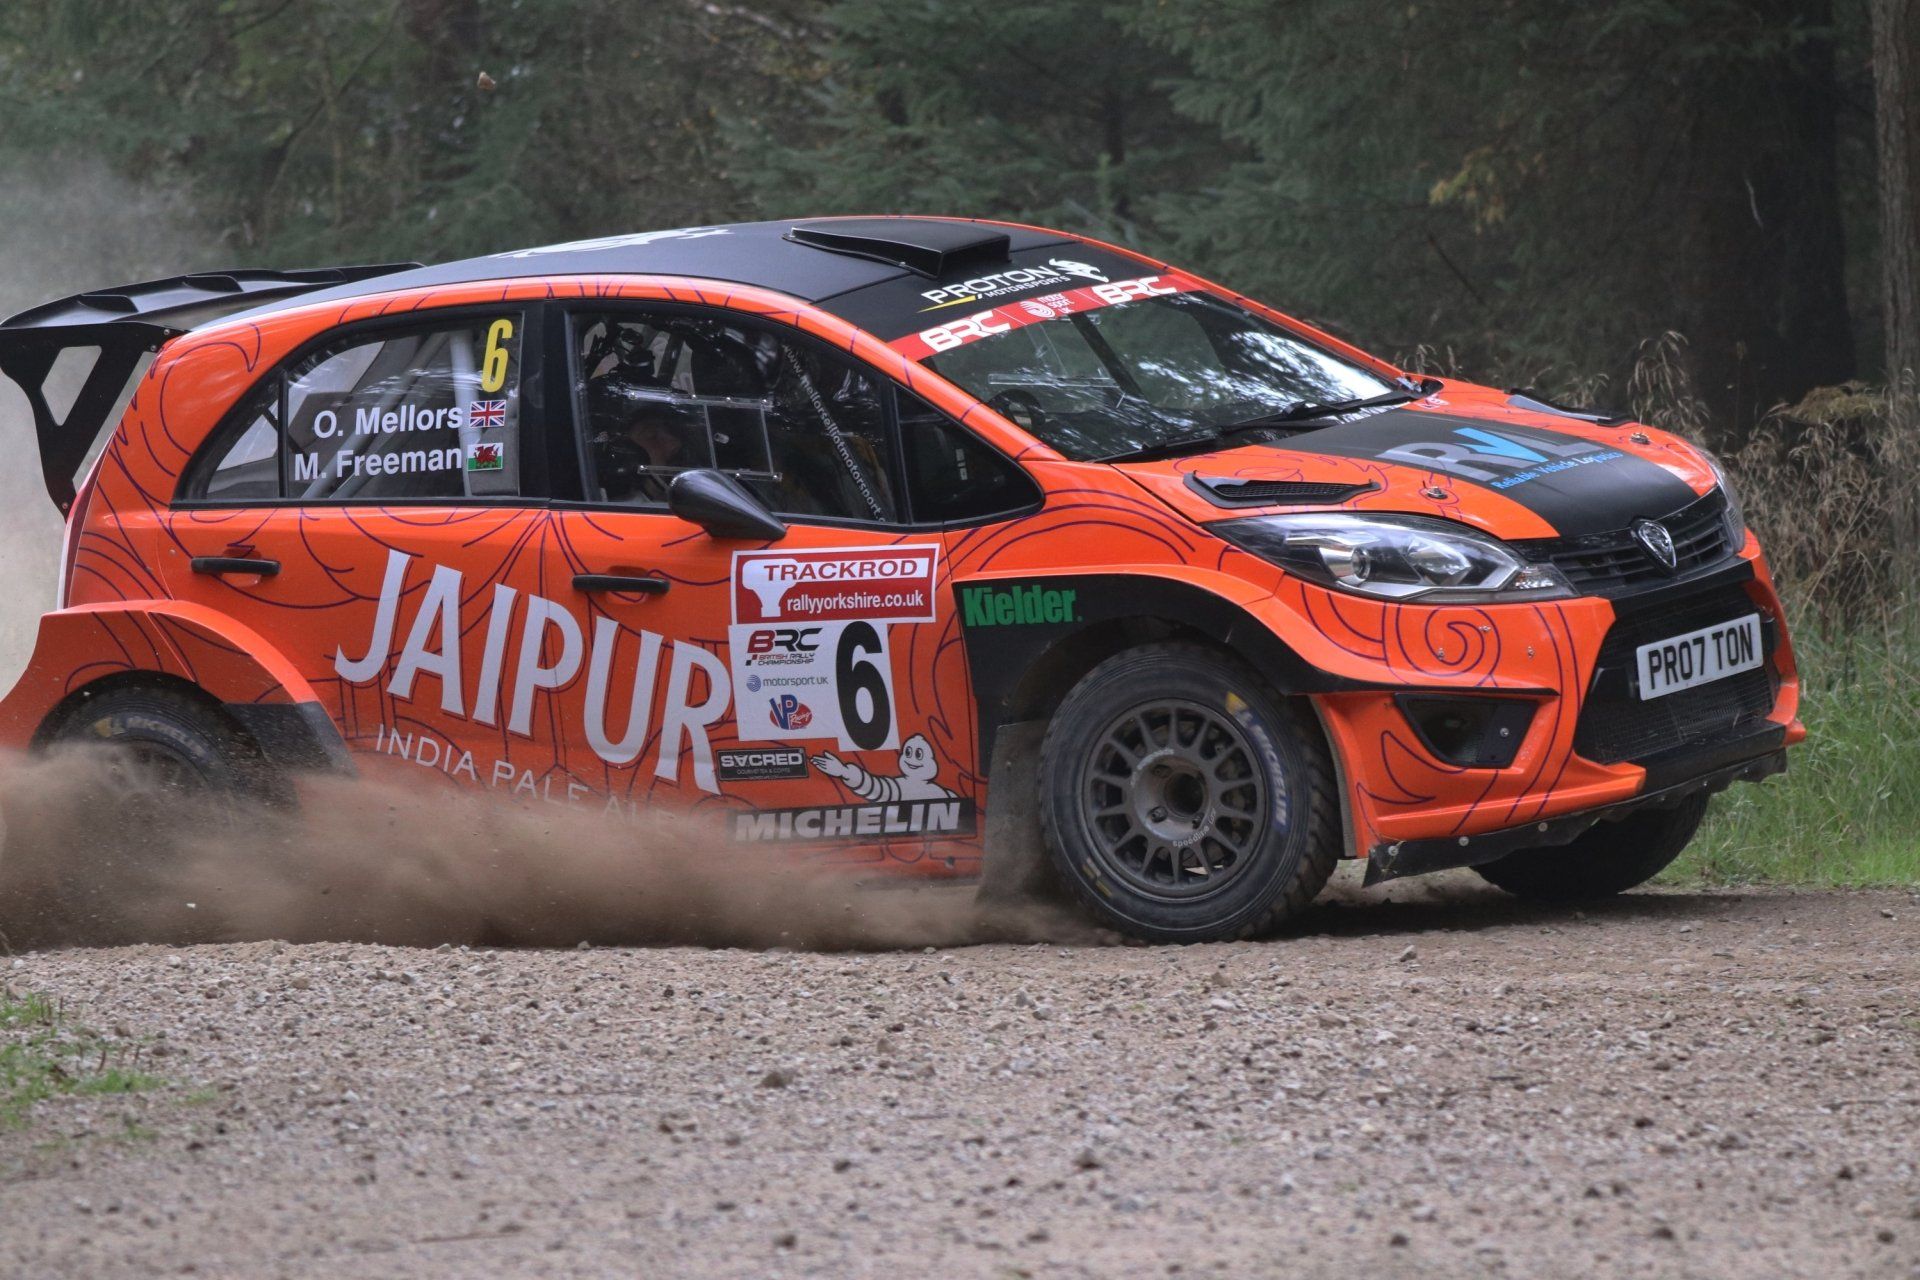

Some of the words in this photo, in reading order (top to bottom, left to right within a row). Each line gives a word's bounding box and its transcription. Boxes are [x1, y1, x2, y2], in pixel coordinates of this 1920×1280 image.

[921, 266, 1058, 304] PROTON
[988, 275, 1071, 298] MOTORSPORTS
[1092, 277, 1177, 305] BRC
[919, 310, 1012, 353] BRC
[481, 319, 513, 393] 6
[314, 410, 344, 439] O.
[355, 404, 463, 436] Mellors
[294, 452, 327, 481] M.
[336, 447, 463, 478] Freeman
[1375, 428, 1604, 481] RVL
[763, 560, 917, 582] TRACKROD
[787, 590, 924, 614] rallyyorkshire.co.uk
[963, 585, 1076, 626] Kielder
[747, 627, 823, 653] BRC
[1712, 623, 1753, 670] TON
[335, 549, 732, 795] JAIPUR
[758, 658, 815, 666] CHAMPIONSHIP
[763, 676, 816, 687] motorsport
[817, 676, 829, 685] UK
[836, 621, 890, 750] 6
[769, 694, 798, 730] VP
[376, 724, 477, 781] INDIA
[492, 760, 588, 807] PALE
[721, 752, 803, 767] SACRED
[735, 802, 960, 842] MICHELIN
